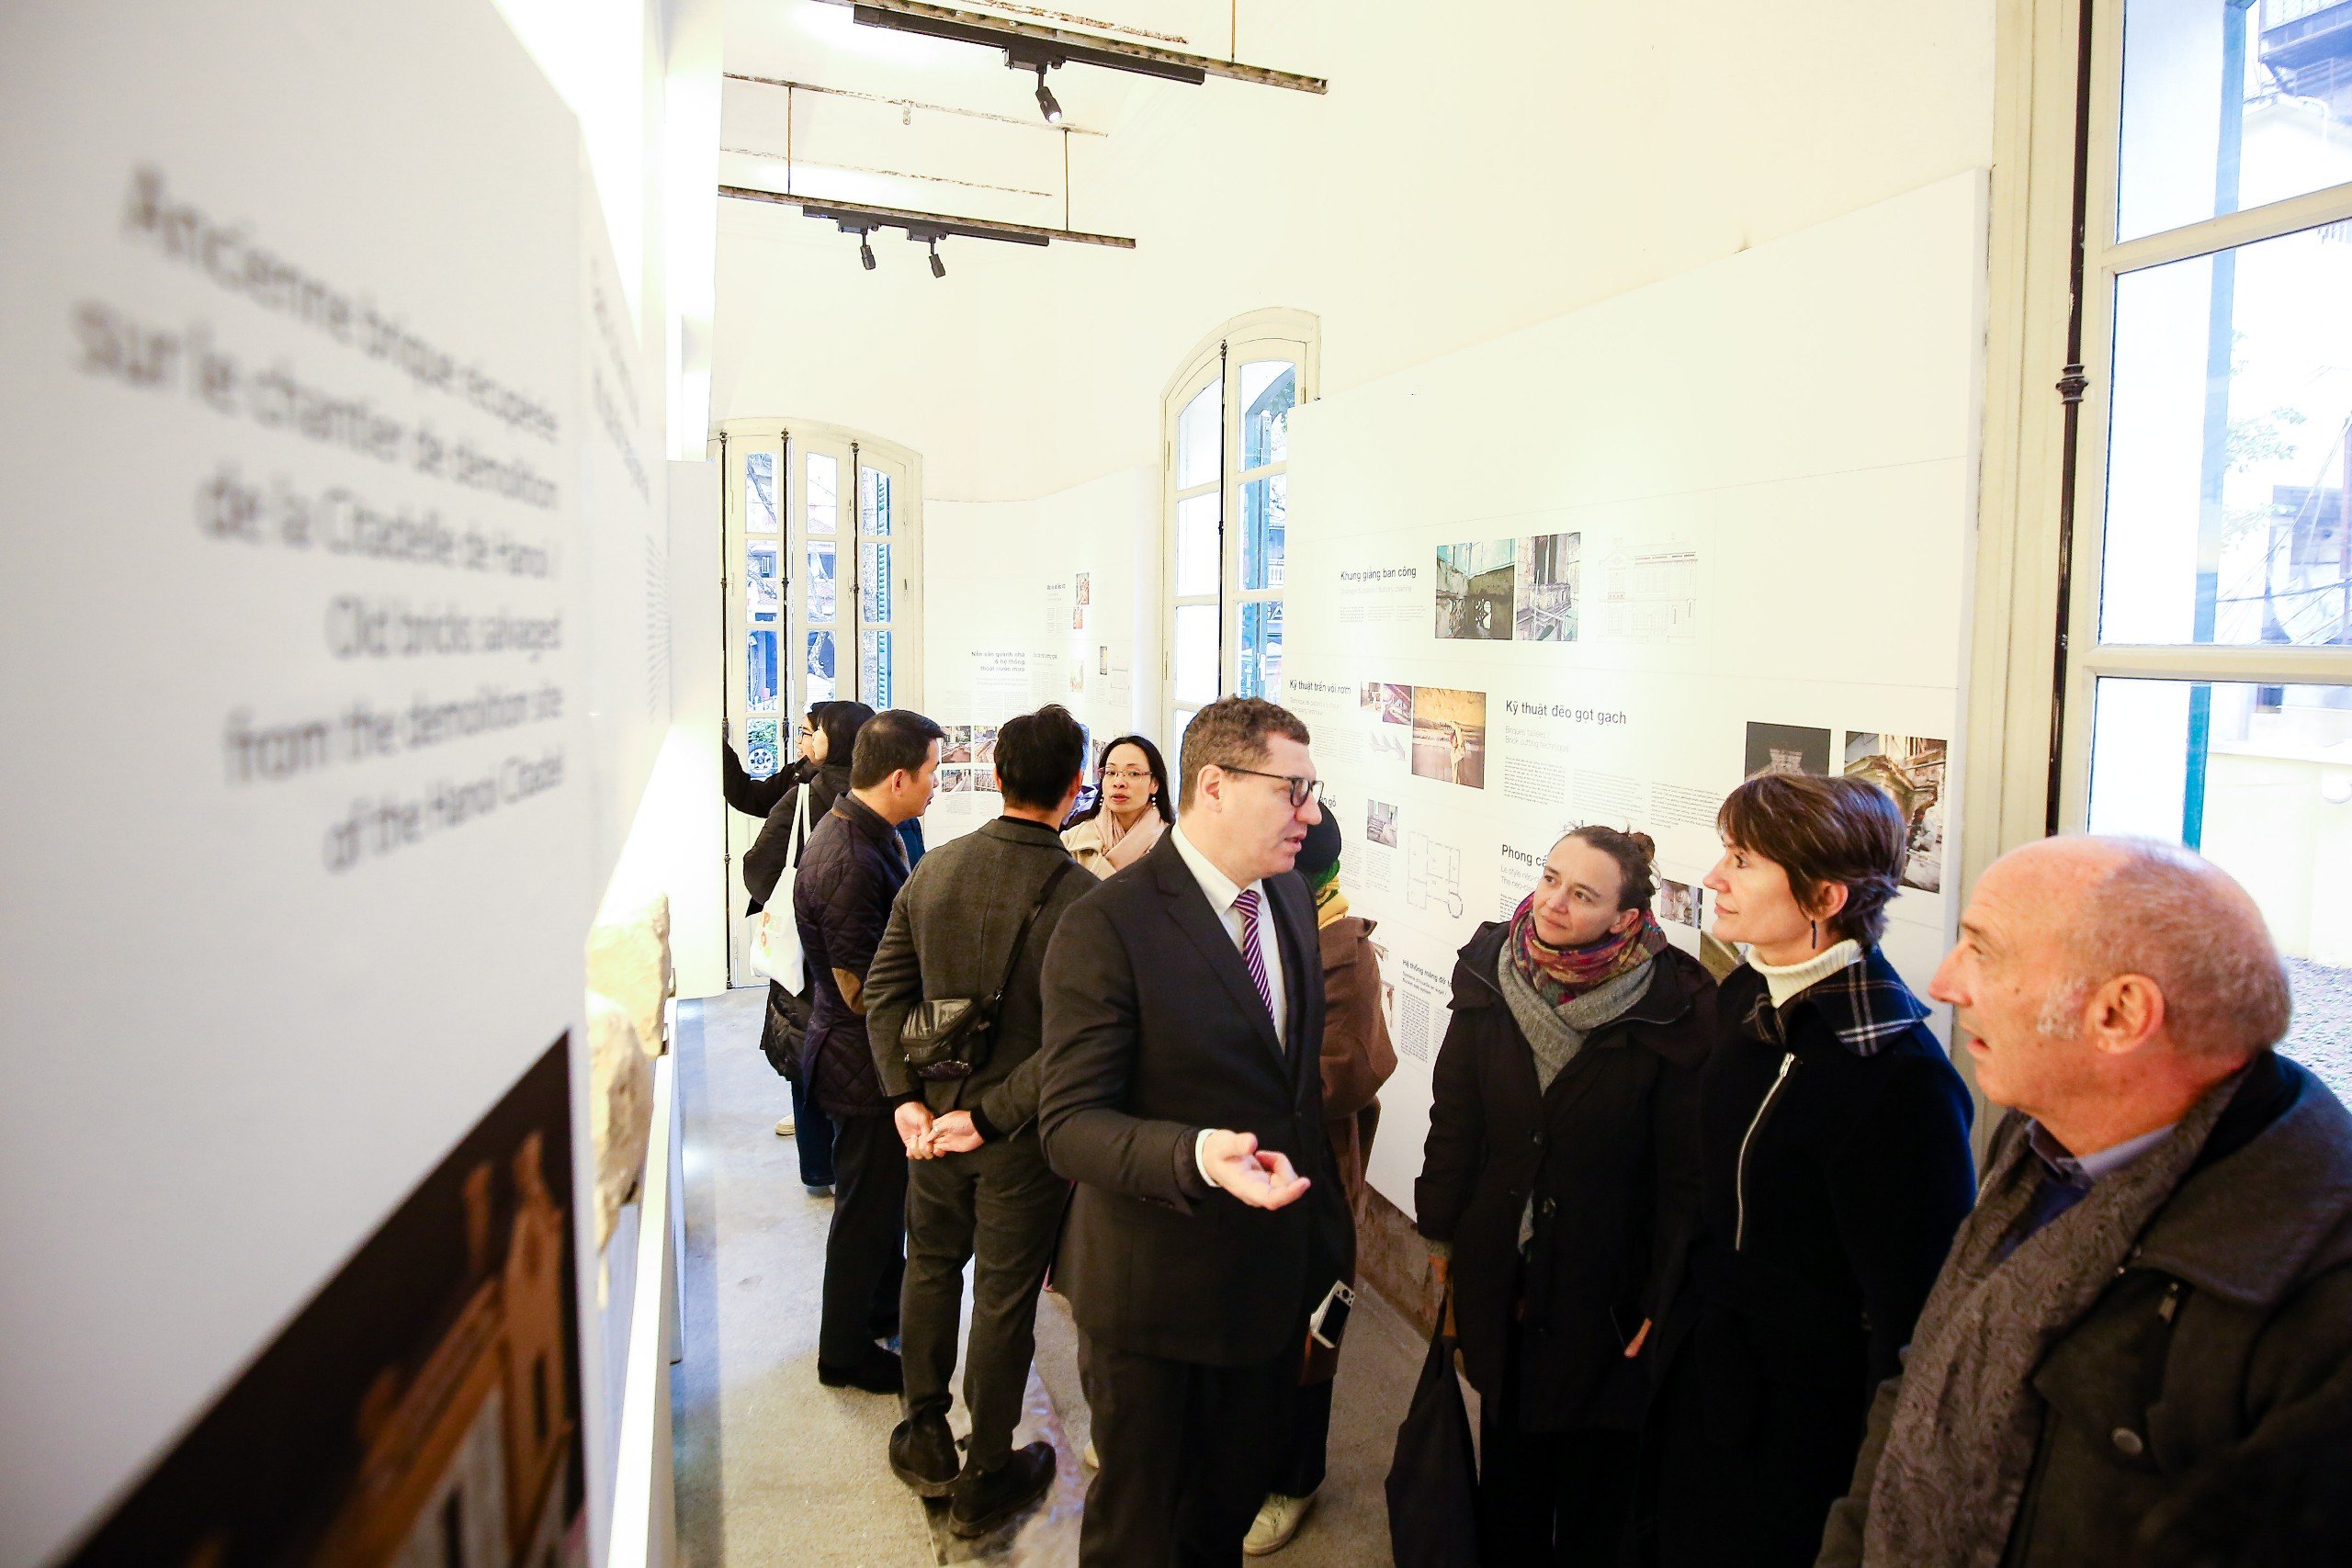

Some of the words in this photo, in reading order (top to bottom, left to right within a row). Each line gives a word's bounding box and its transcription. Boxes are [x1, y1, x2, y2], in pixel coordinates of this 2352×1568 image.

[1340, 570, 1361, 582] Khung
[1383, 568, 1396, 579] ban
[1397, 566, 1417, 579] công
[324, 592, 393, 661] Old
[1506, 700, 1519, 716] Kỹ
[1521, 702, 1547, 719] thuật
[1575, 708, 1594, 724] gọt
[1598, 711, 1626, 727] gạch
[221, 704, 333, 790] from
[1501, 844, 1532, 866] Phong
[1535, 854, 1547, 868] cá
